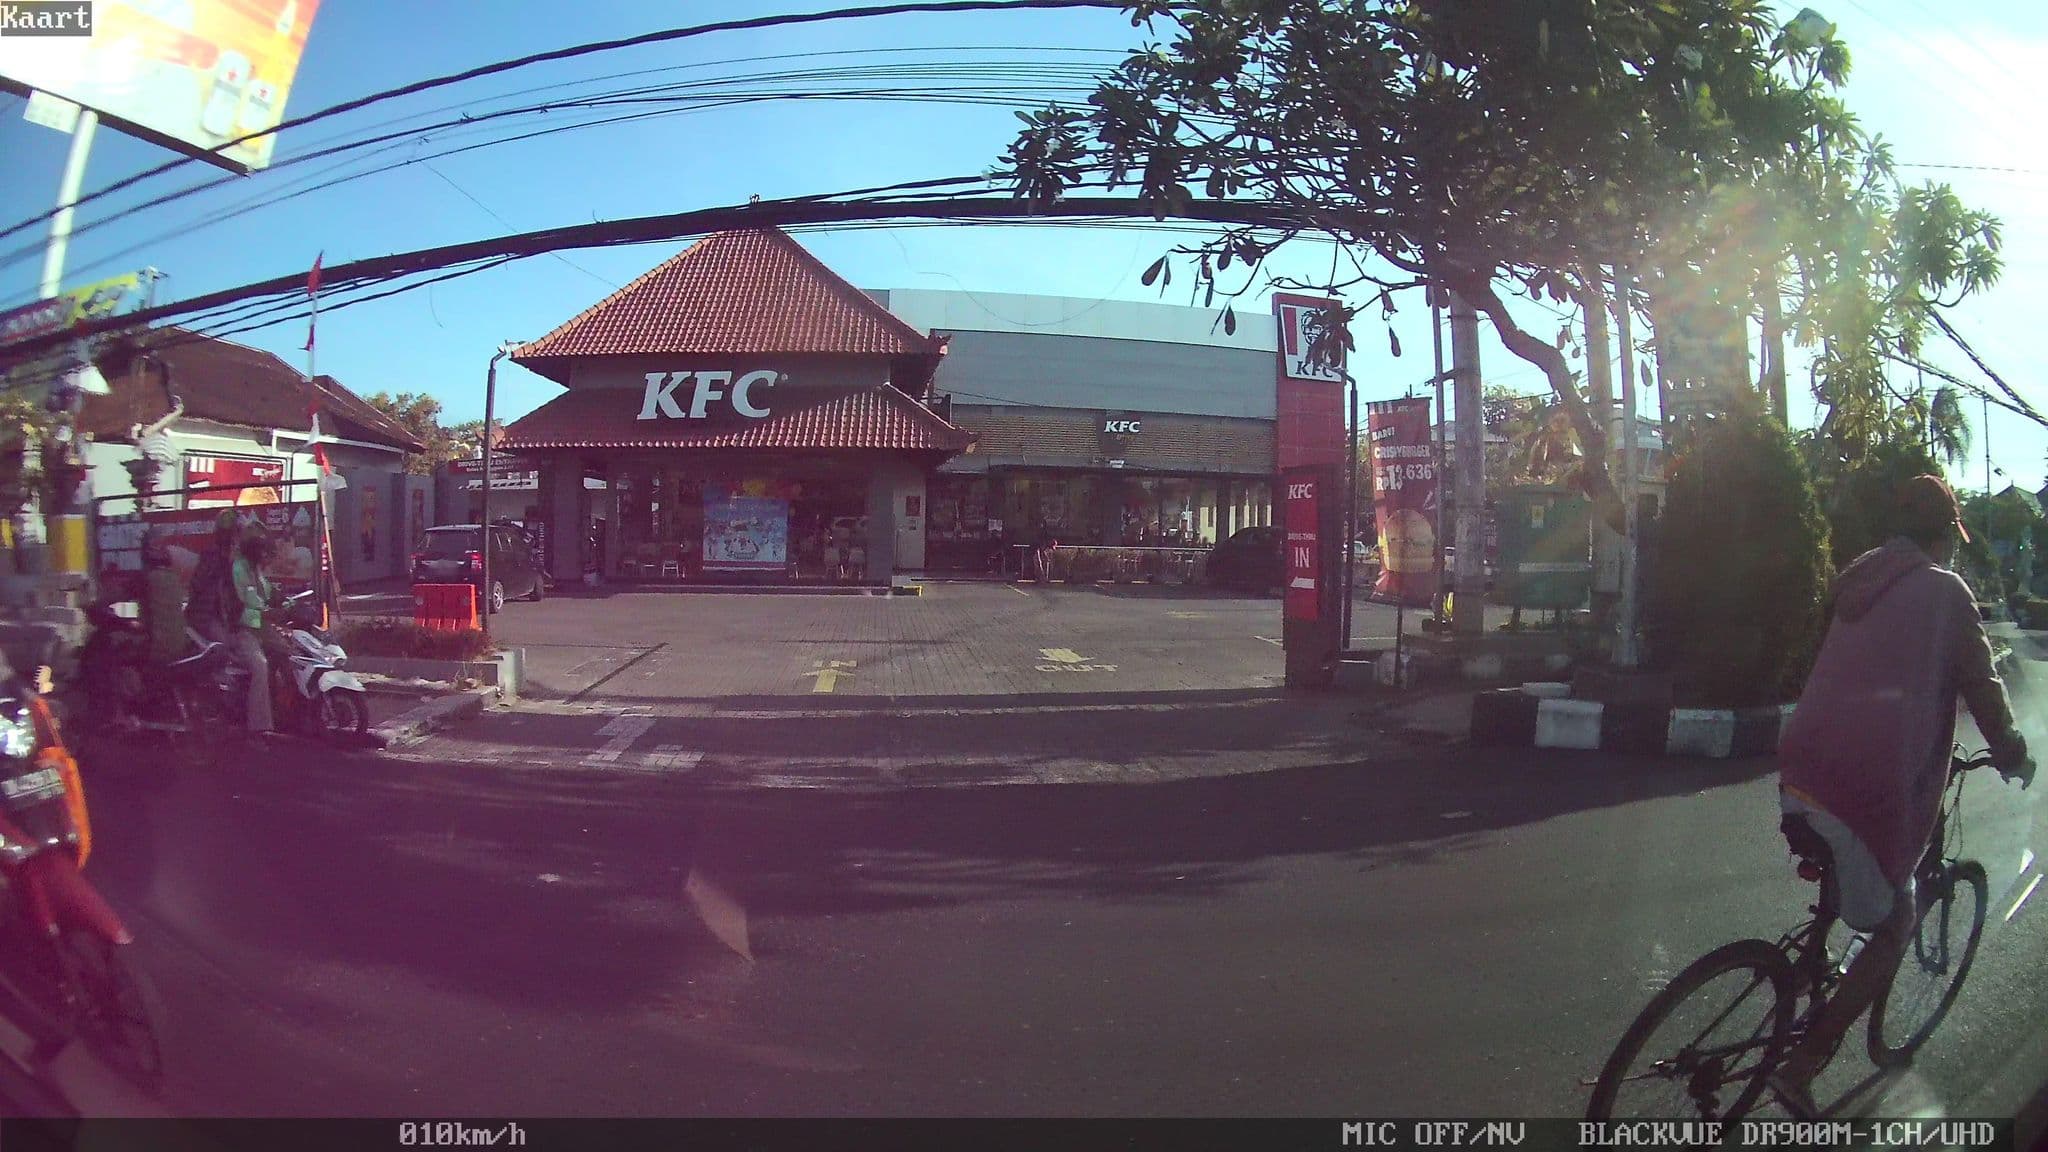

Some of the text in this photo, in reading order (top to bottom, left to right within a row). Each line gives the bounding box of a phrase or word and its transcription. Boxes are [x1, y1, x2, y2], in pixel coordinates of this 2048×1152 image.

[637, 370, 778, 421] KFC
[1103, 420, 1141, 433] KFC
[1288, 483, 1313, 499] KFC
[1295, 546, 1310, 568] IN
